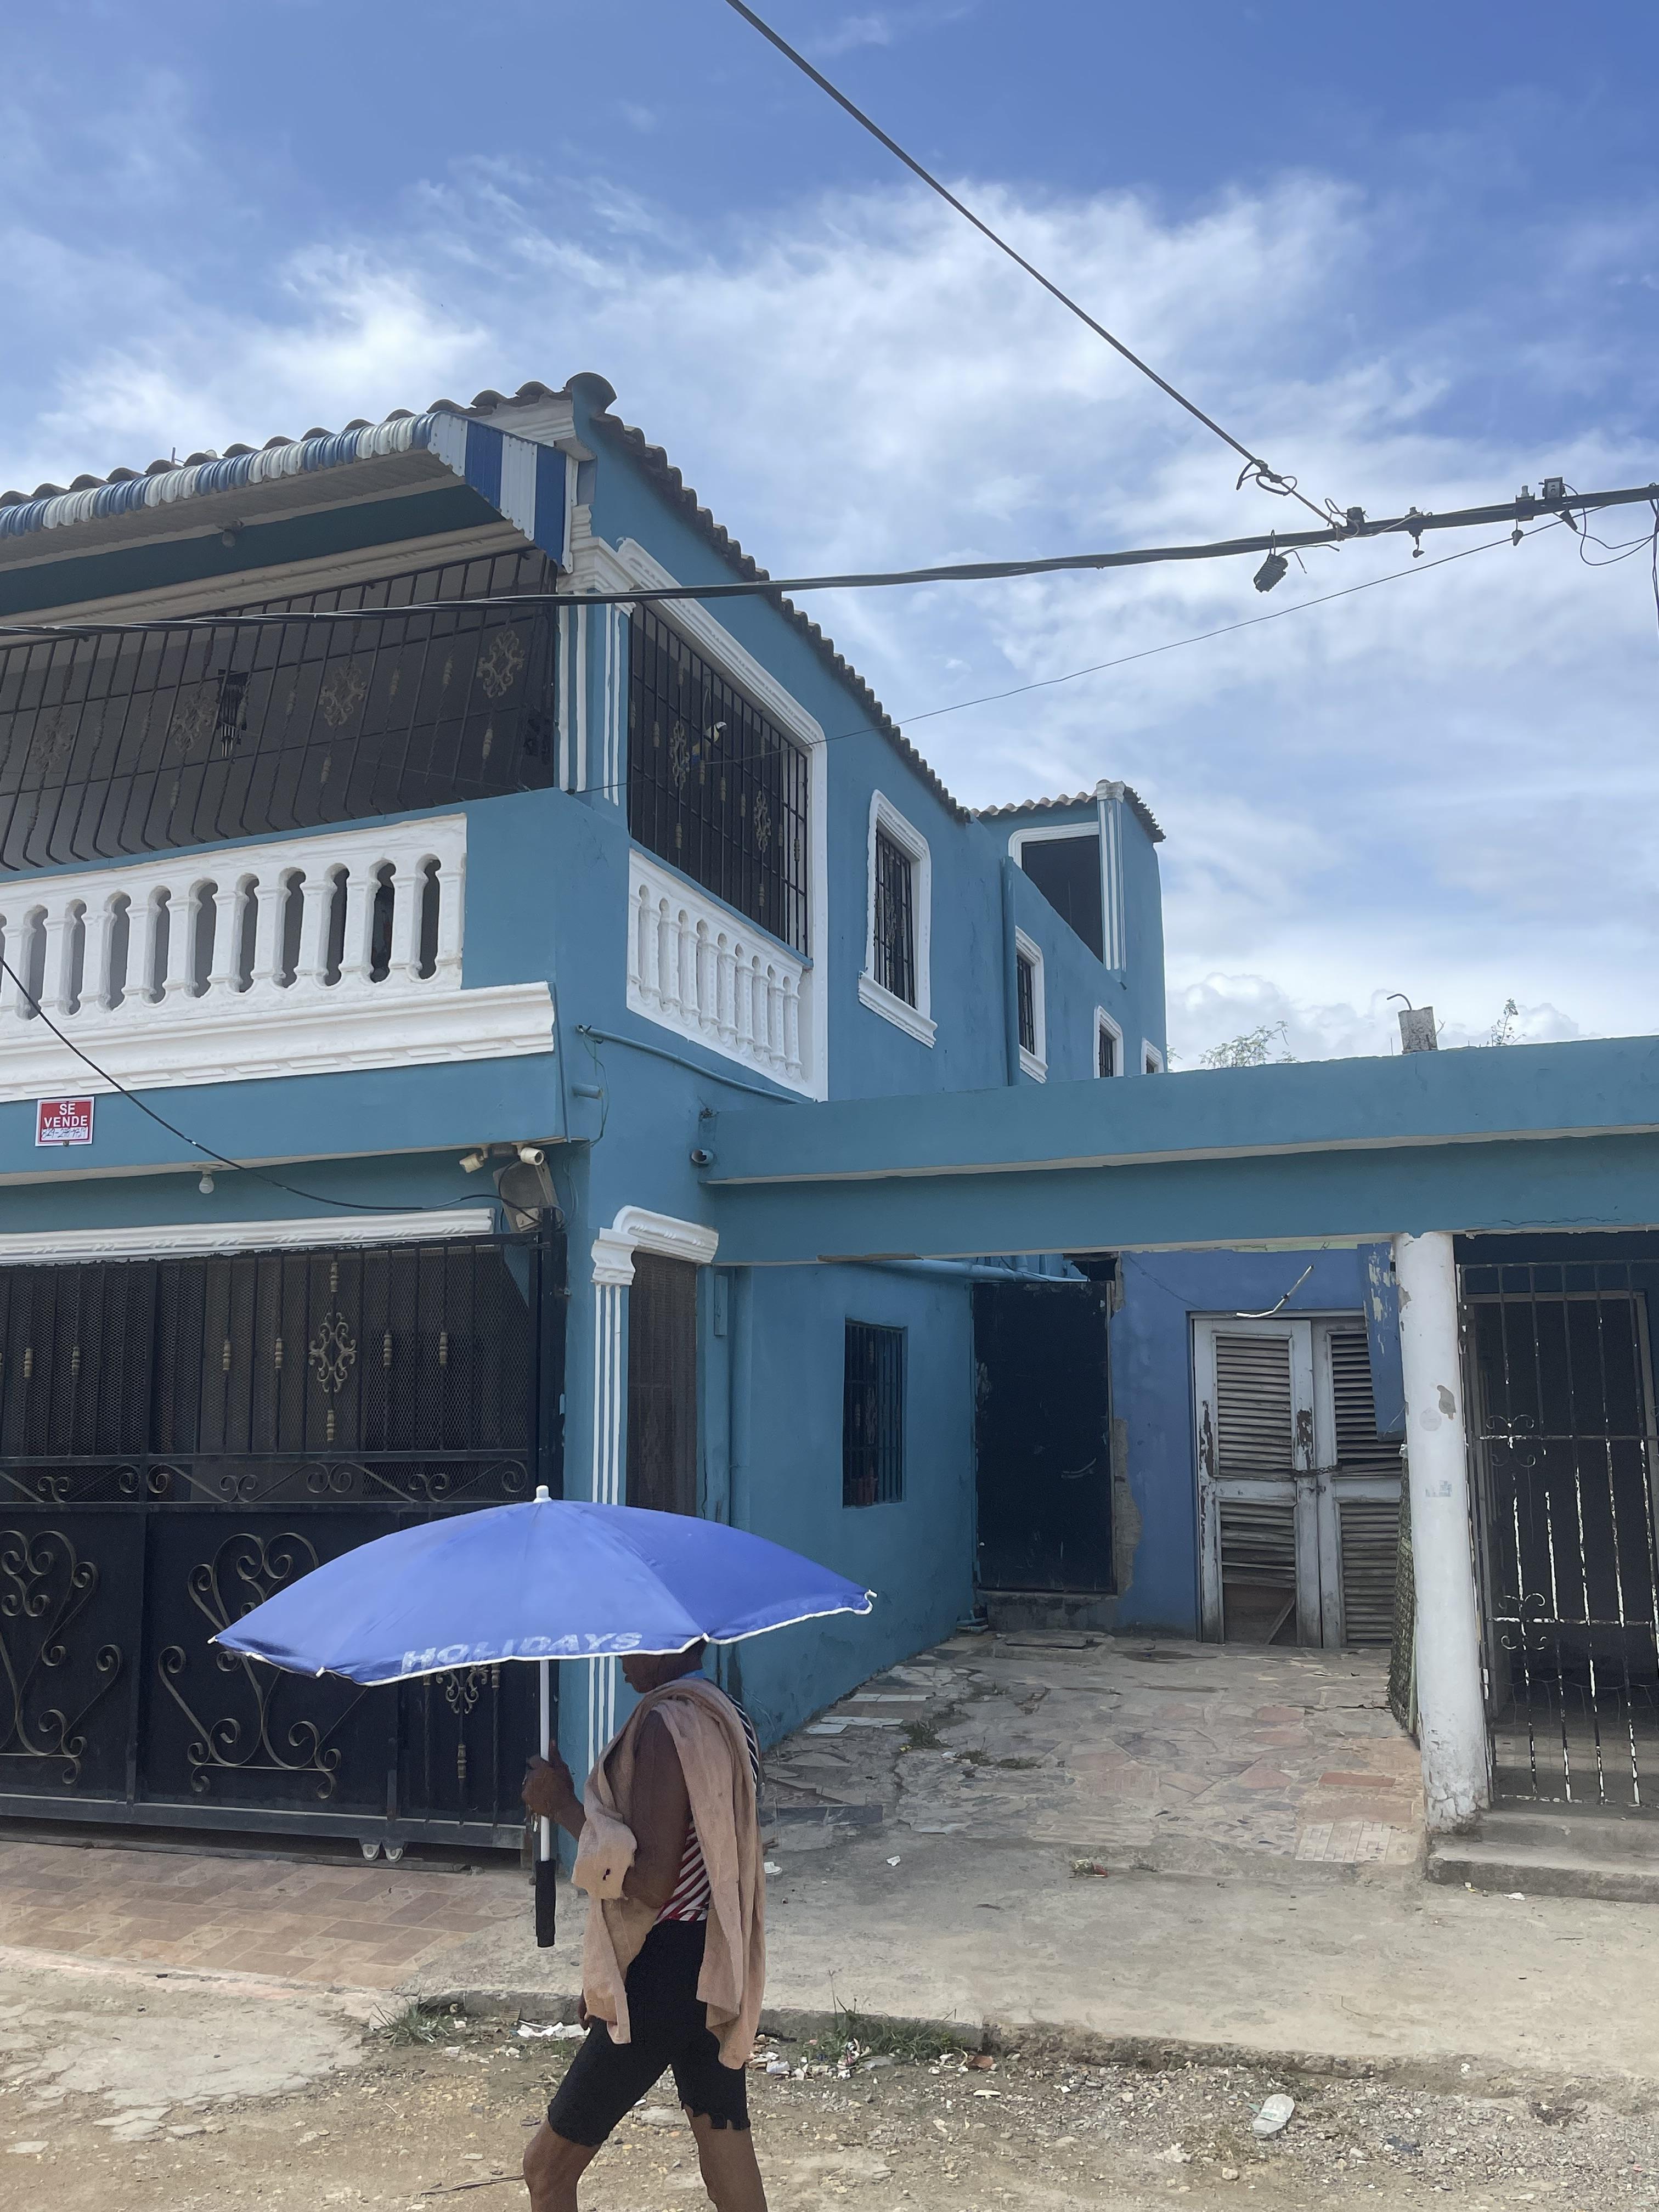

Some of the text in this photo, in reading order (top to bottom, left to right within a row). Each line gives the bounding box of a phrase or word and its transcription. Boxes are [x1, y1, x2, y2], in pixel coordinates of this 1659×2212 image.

[59, 1103, 76, 1115] SE
[44, 1115, 88, 1127] VENDE
[401, 1632, 642, 1675] HOLIDAYS
